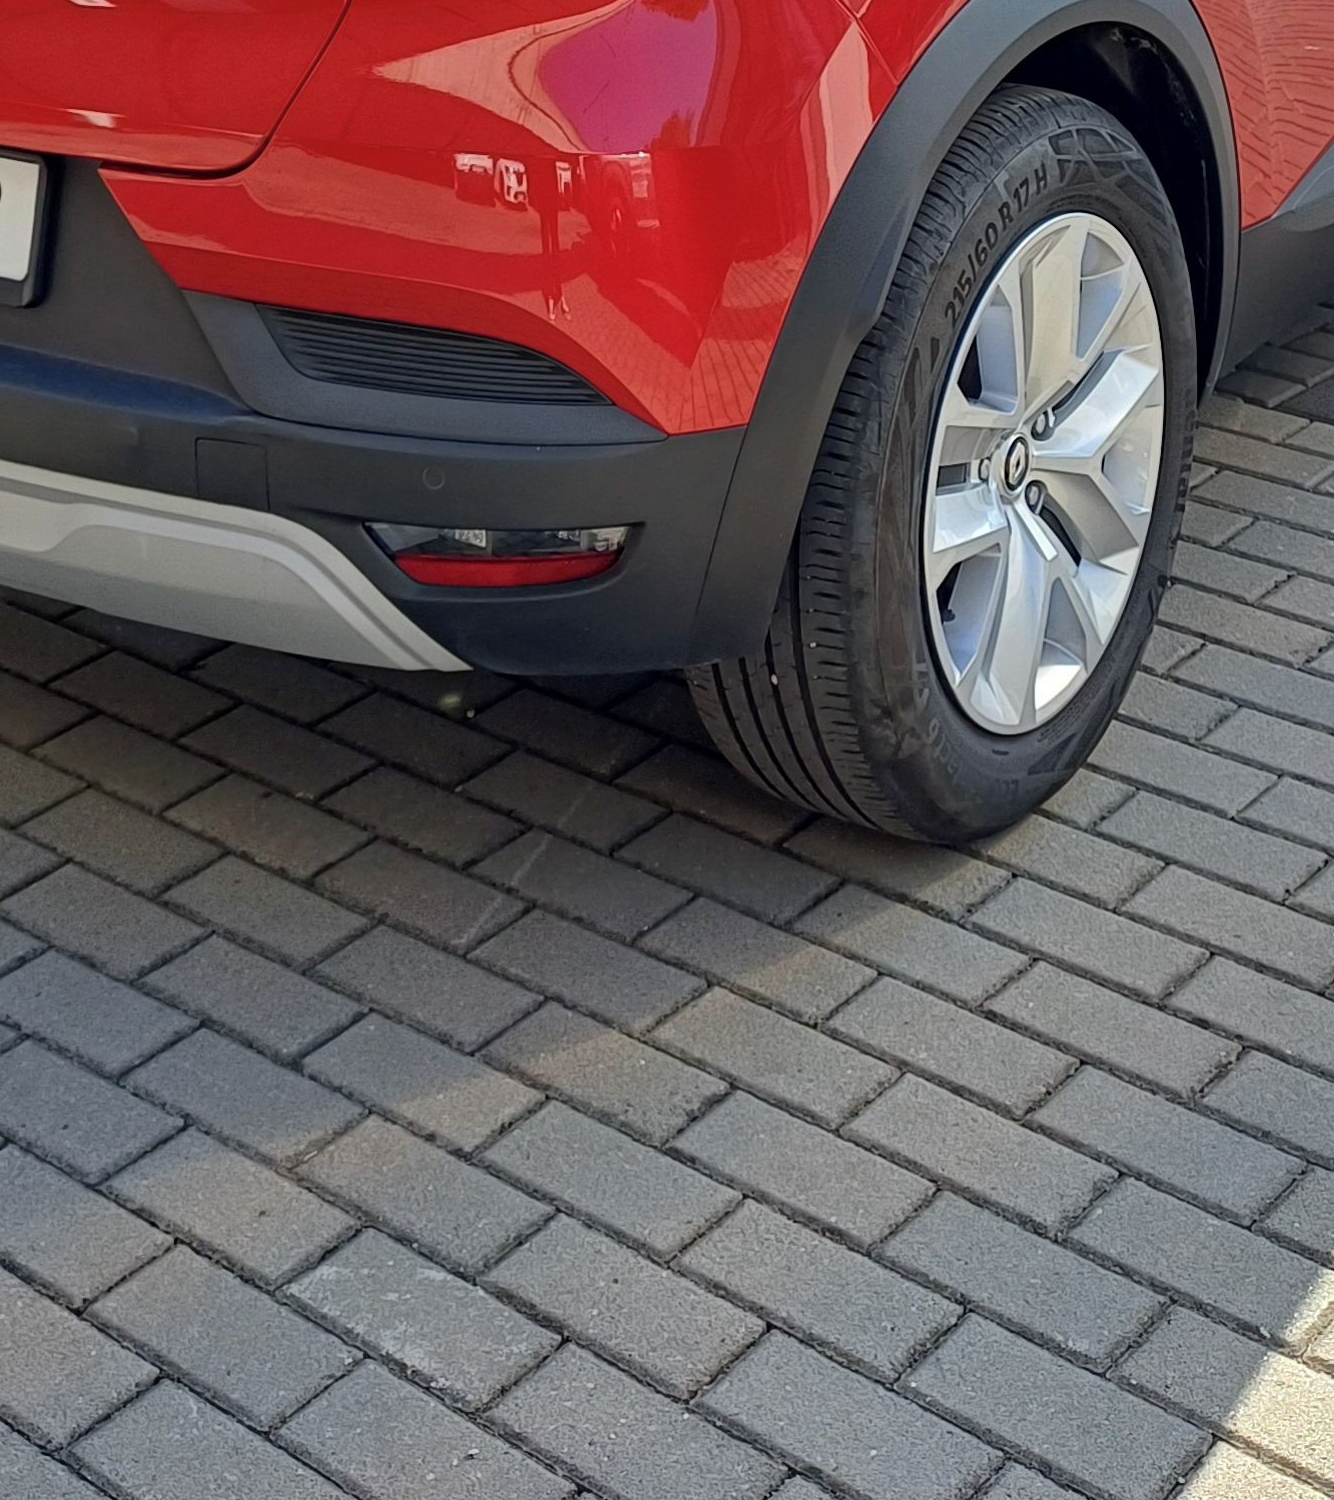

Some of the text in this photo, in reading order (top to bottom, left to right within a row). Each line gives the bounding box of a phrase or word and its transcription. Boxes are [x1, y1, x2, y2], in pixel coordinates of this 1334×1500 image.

[944, 161, 1049, 330] 215/60 R 17 H
